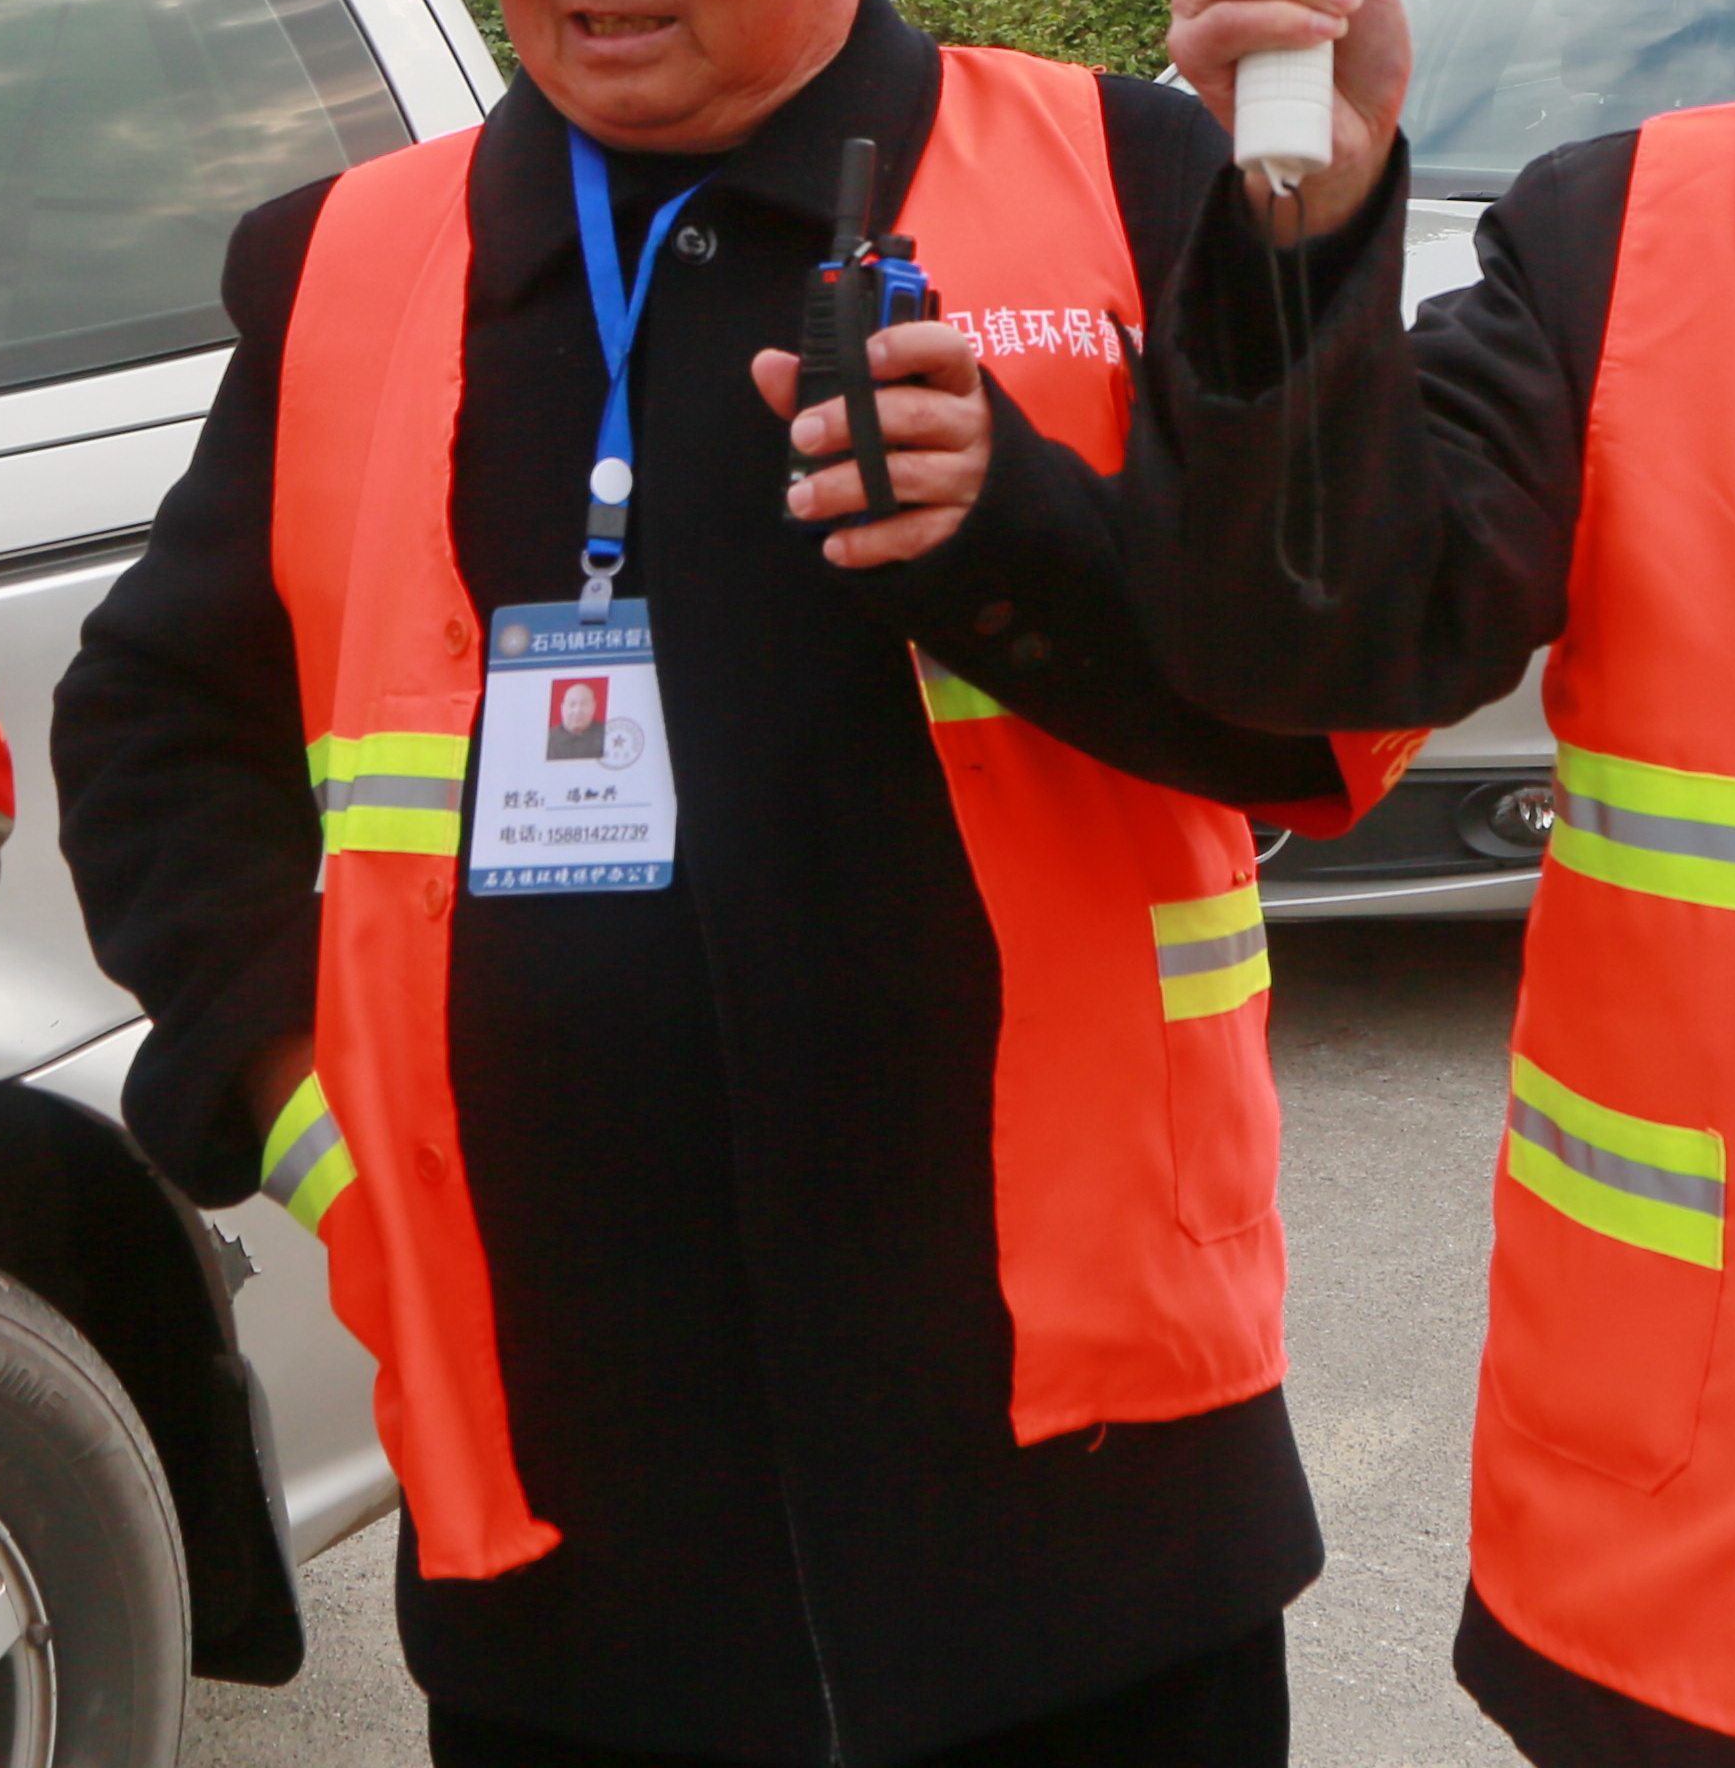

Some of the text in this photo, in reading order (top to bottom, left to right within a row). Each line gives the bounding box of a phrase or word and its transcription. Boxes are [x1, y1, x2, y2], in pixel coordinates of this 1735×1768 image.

[482, 863, 660, 889] 石马镇环境保护办公室
